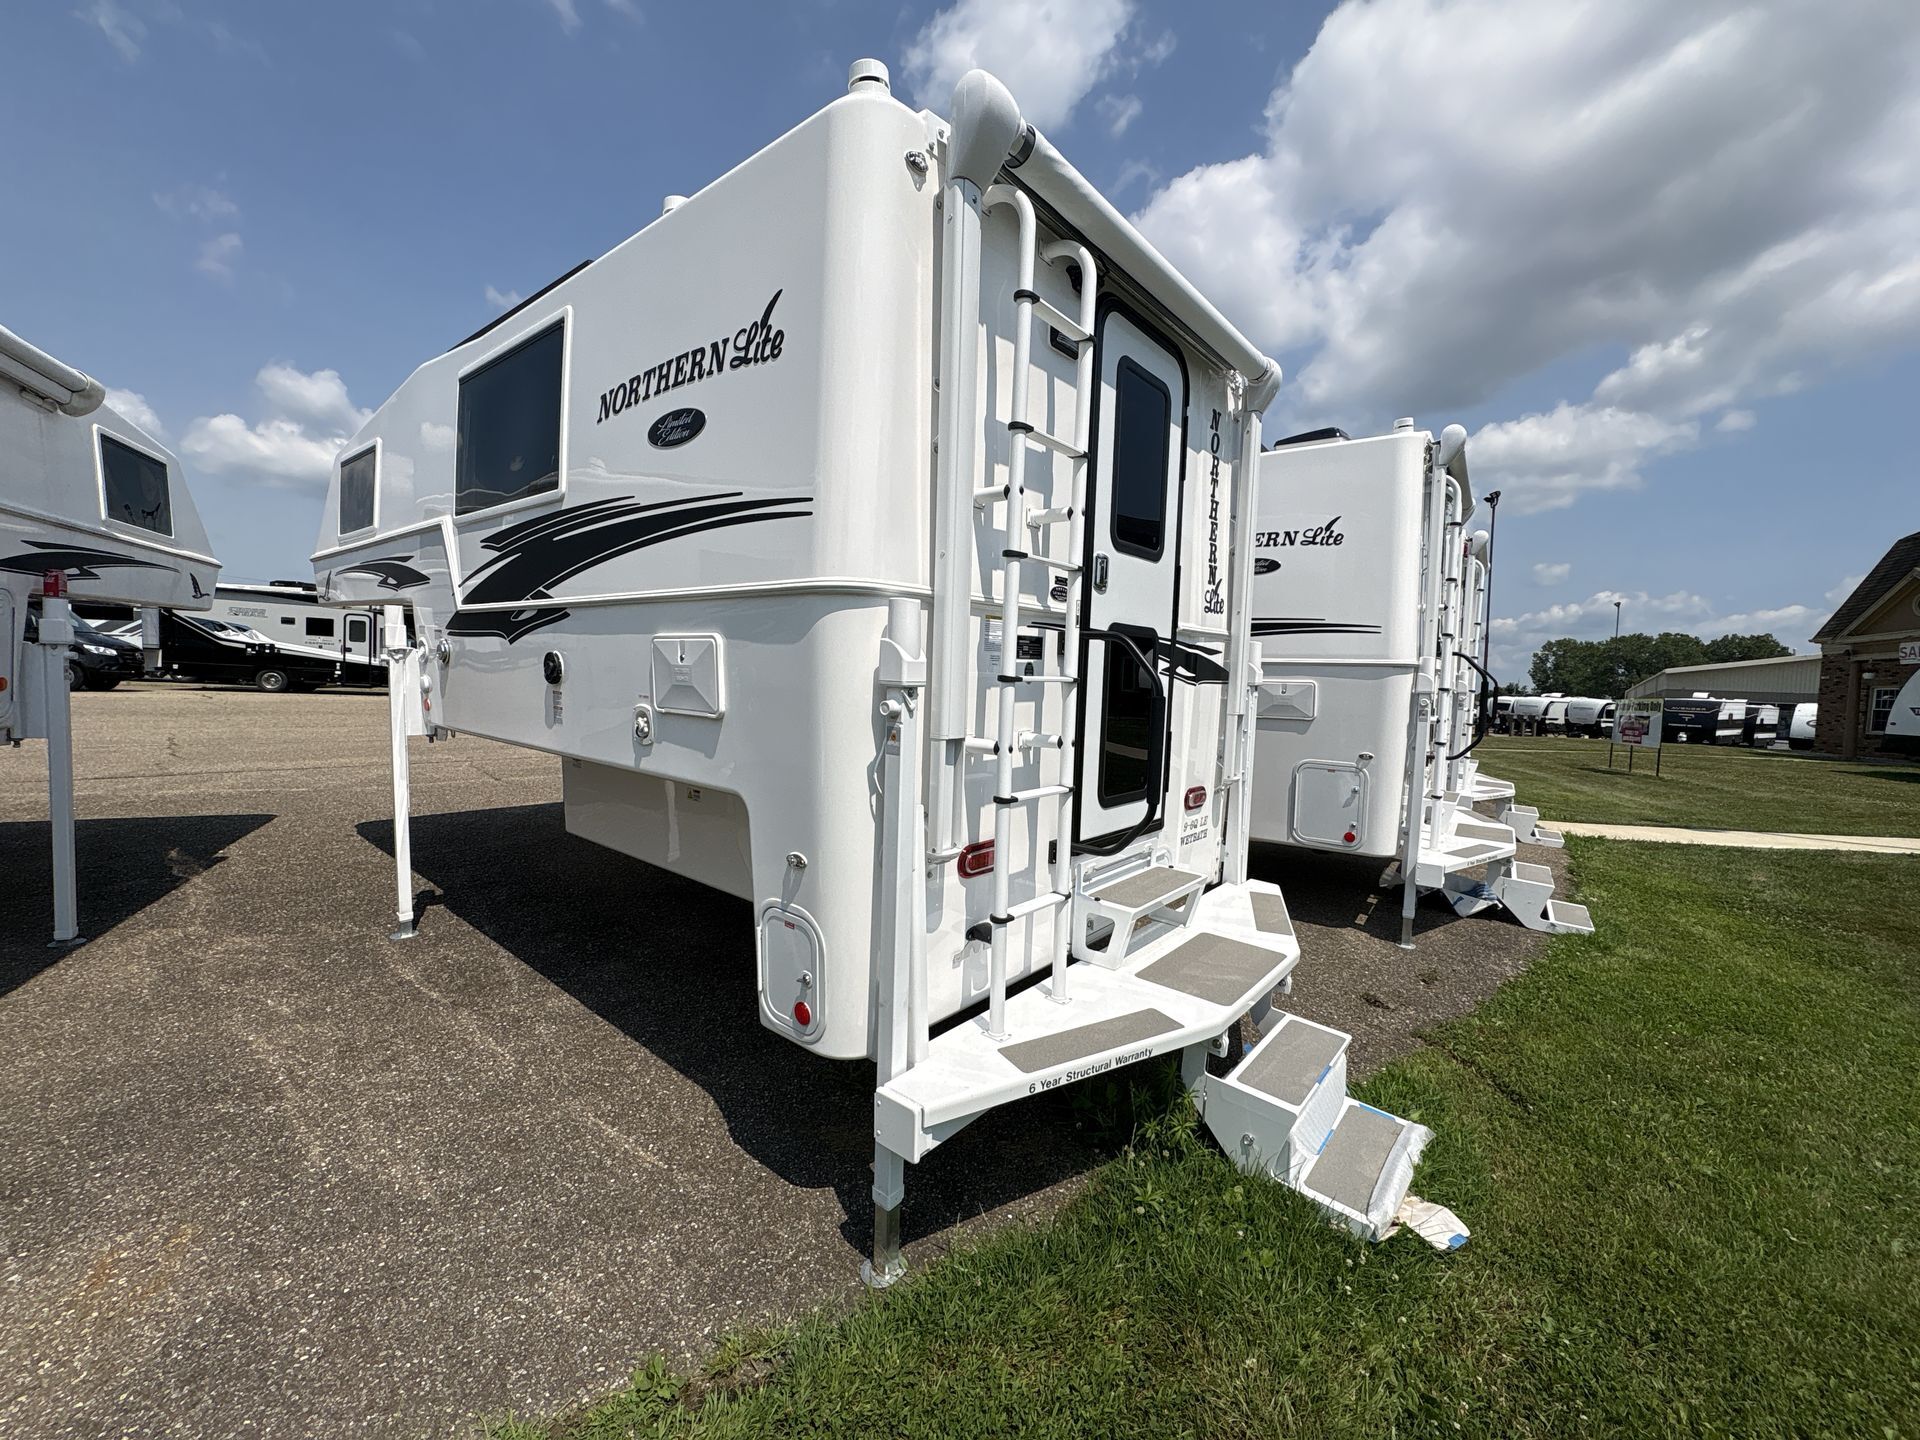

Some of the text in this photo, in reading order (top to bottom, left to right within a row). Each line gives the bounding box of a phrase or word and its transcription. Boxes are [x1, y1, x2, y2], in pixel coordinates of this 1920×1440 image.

[597, 289, 784, 424] NORTHERN Lite
[657, 410, 696, 434] Limited
[657, 427, 690, 445] Edition
[1204, 408, 1225, 614] NORTHERN Lite
[1300, 515, 1345, 546] Lite
[1899, 646, 1920, 659] SA
[1028, 1047, 1153, 1094] 6 Year Structural Warranty
